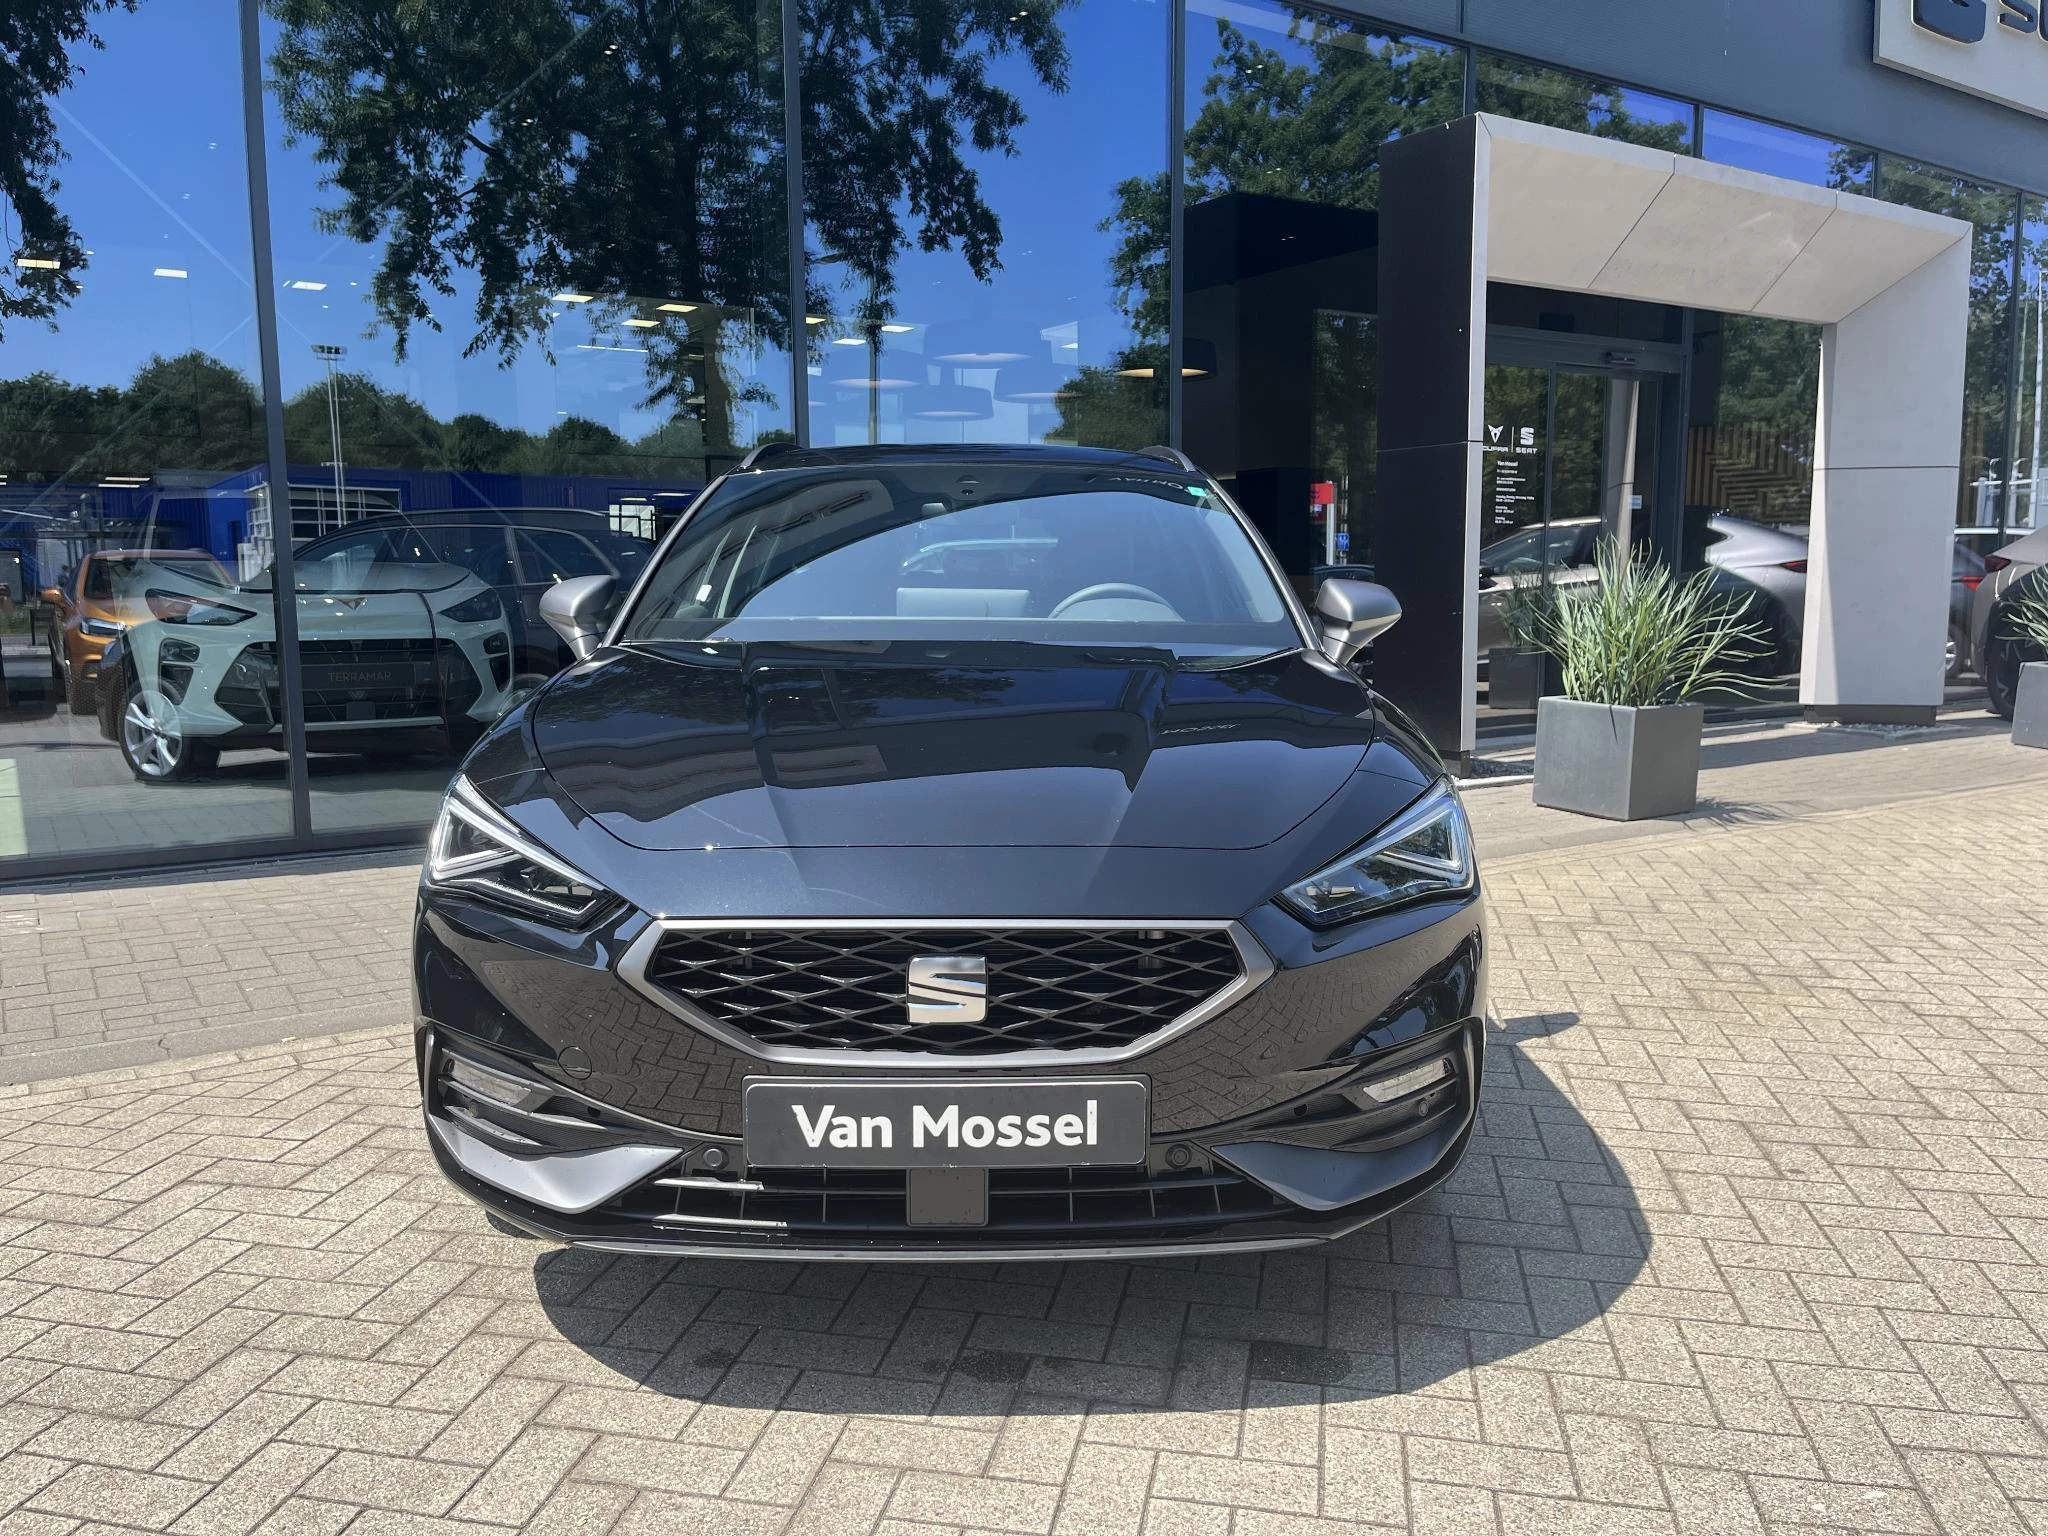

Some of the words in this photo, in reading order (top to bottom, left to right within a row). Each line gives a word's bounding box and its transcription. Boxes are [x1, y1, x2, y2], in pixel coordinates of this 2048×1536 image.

[327, 671, 392, 682] TERRAMAR
[791, 1104, 893, 1149] Van
[912, 1099, 1098, 1149] Mossel
